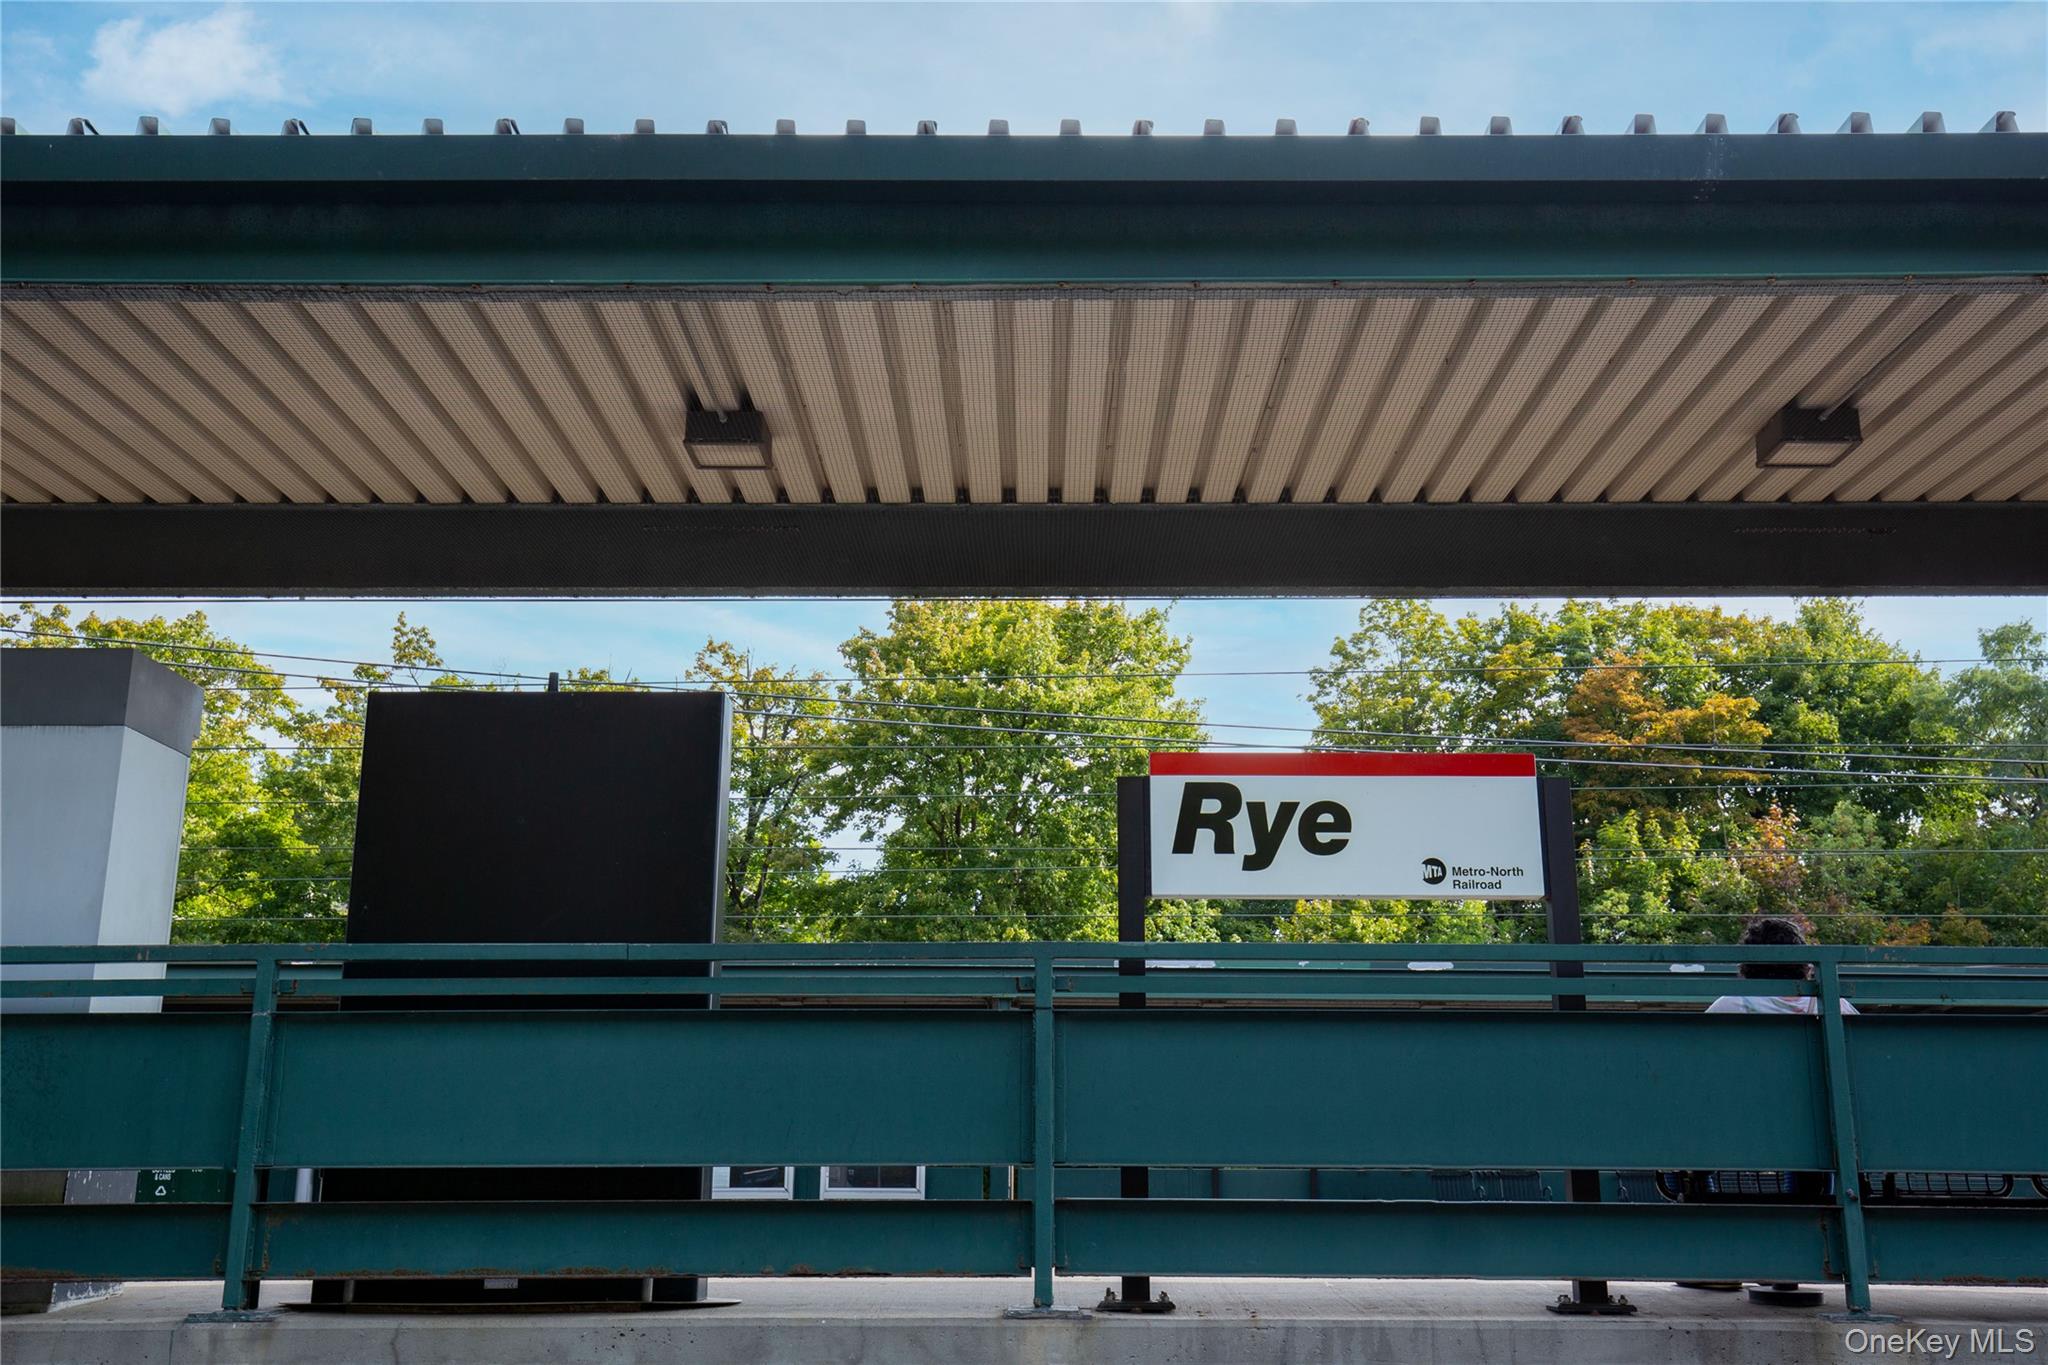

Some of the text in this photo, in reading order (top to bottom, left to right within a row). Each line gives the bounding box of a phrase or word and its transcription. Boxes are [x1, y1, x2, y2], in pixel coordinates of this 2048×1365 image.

[1171, 781, 1353, 872] Rye
[1451, 866, 1524, 877] Metro-North
[1452, 879, 1502, 890] Railroad
